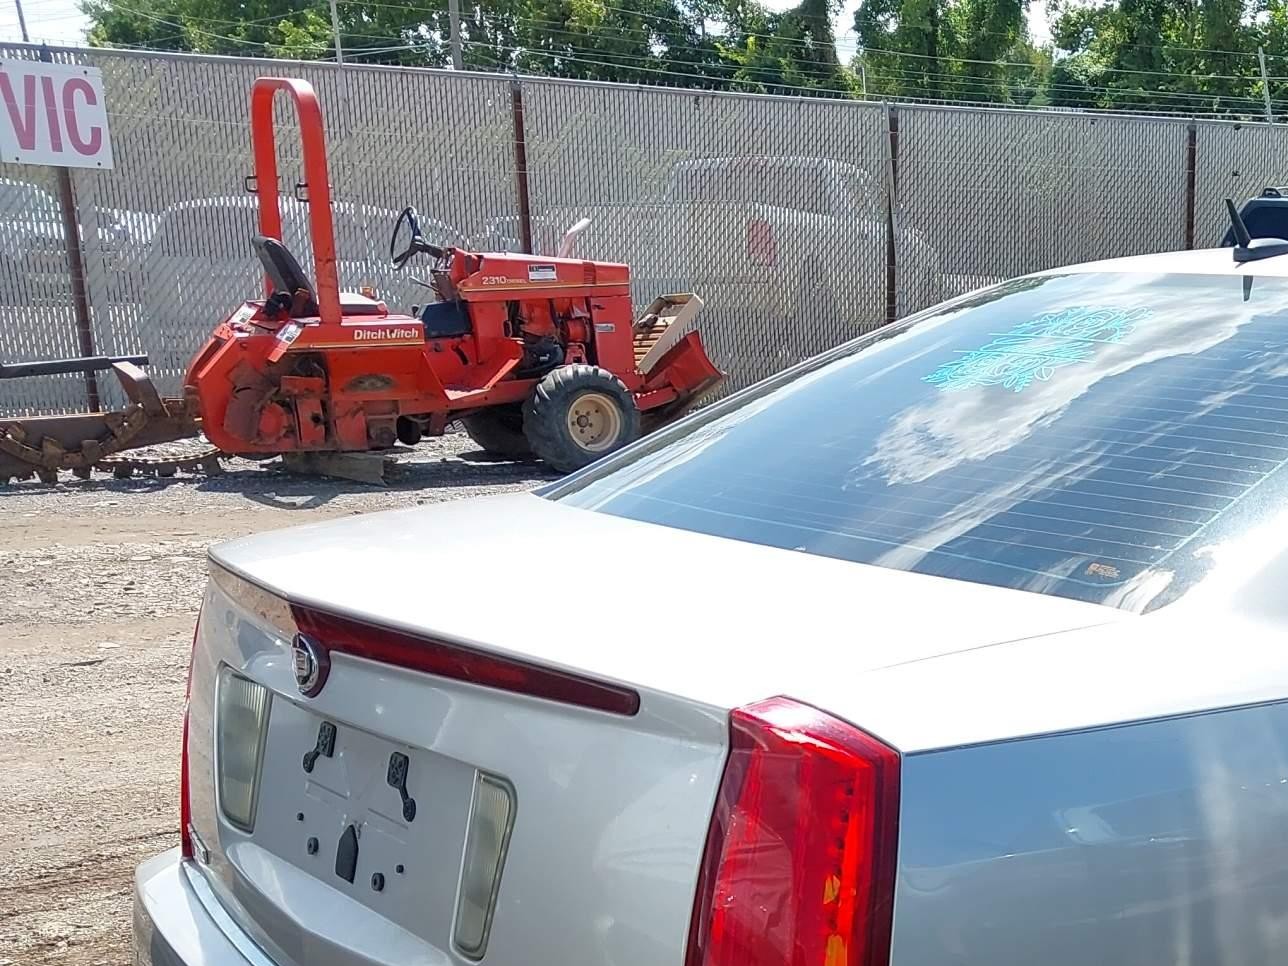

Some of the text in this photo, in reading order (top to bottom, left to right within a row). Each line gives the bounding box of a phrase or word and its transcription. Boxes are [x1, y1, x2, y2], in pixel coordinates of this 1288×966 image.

[0, 72, 103, 156] VIC
[481, 276, 506, 285] 2310
[354, 327, 419, 340] Ditch Witch
